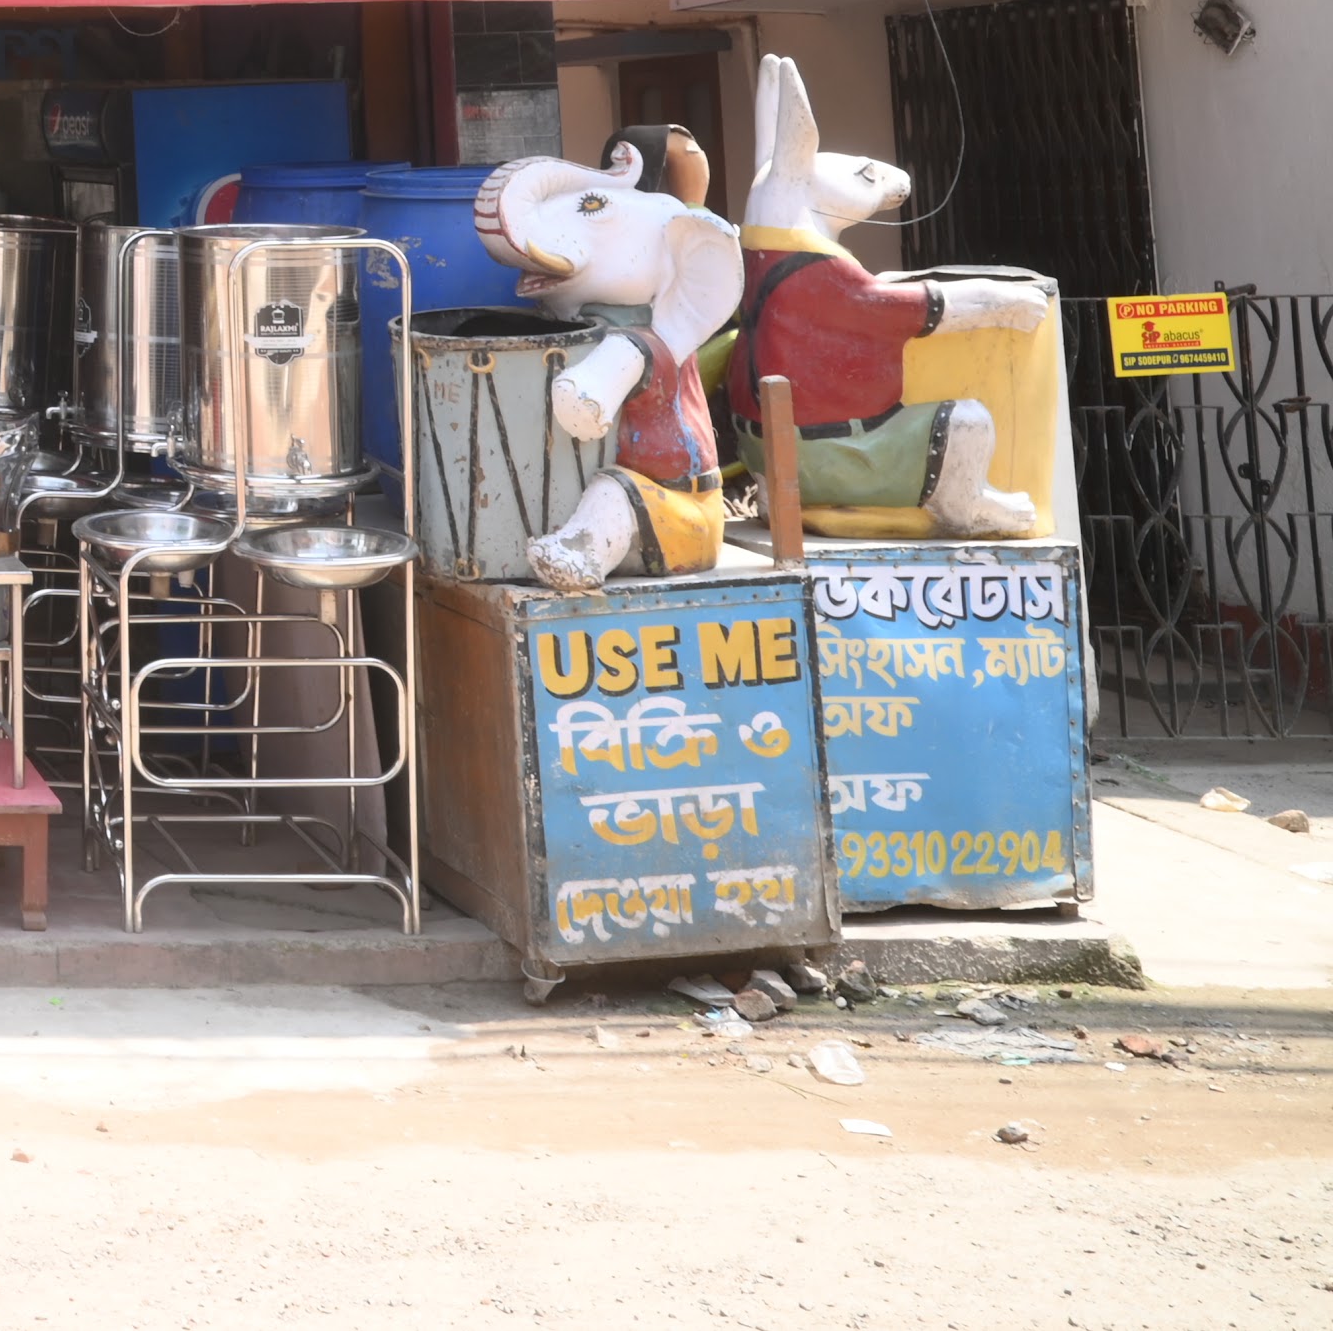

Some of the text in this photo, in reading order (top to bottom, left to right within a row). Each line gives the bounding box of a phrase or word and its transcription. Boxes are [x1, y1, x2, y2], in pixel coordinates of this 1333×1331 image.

[1137, 301, 1218, 316] NO PARKING
[1124, 356, 1136, 366] SIP
[1138, 354, 1172, 366] SODEPUR
[536, 617, 801, 697] USE ME
[549, 696, 791, 776] বিক্রি ও
[580, 782, 766, 860] ভাড়া
